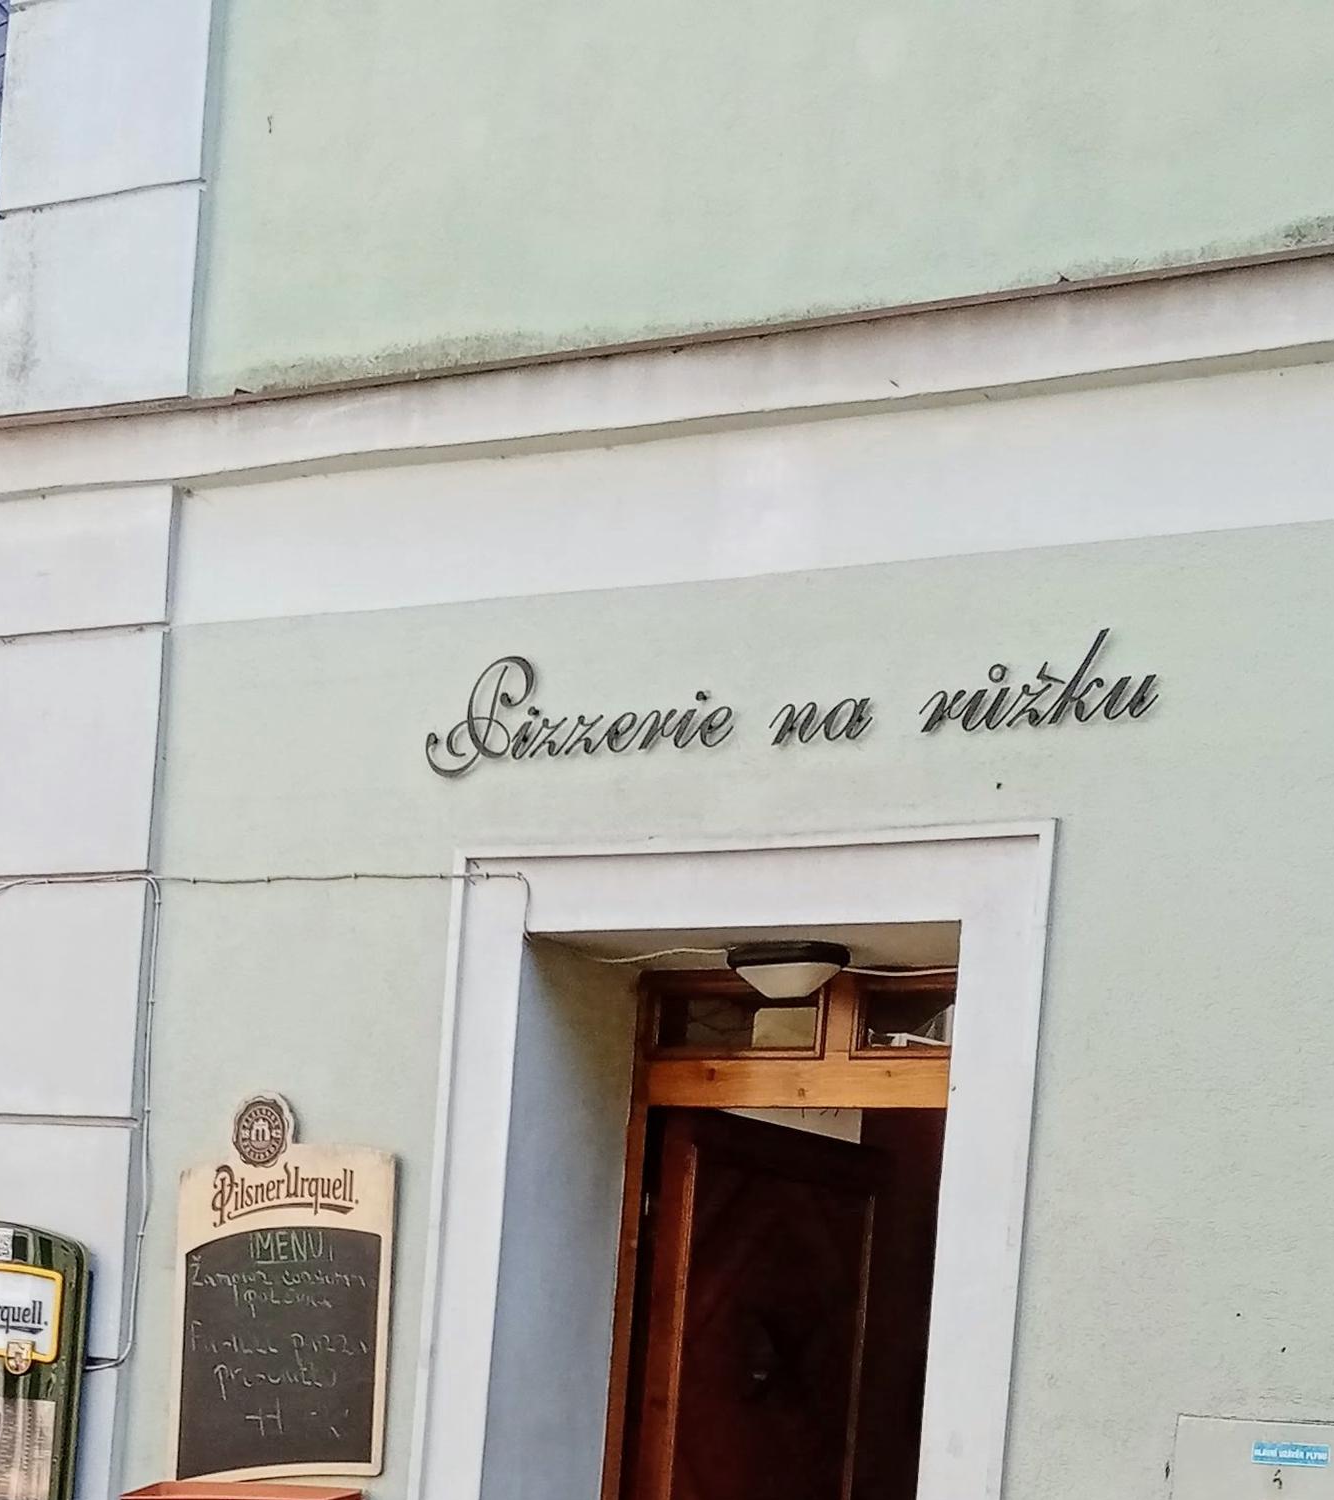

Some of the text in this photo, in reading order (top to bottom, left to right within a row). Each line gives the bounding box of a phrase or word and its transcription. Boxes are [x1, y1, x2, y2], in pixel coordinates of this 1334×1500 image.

[426, 628, 1159, 778] Pizzerie na růžku
[211, 1162, 355, 1228] Pilsner Urquell
